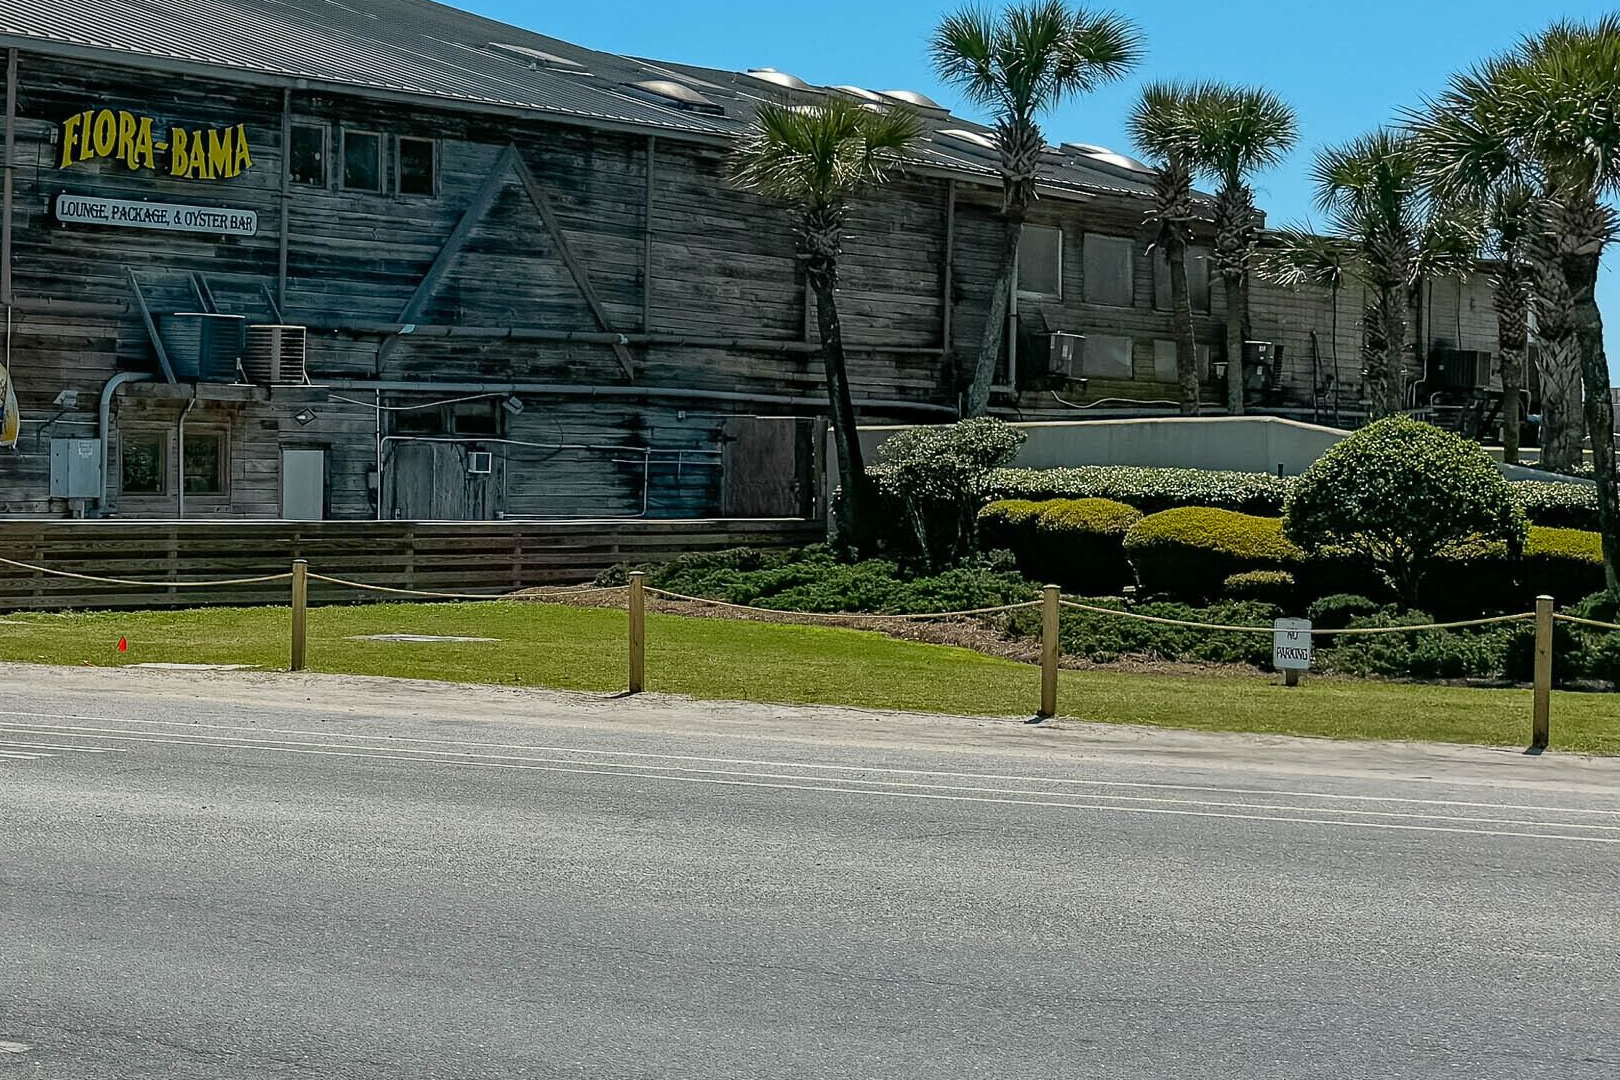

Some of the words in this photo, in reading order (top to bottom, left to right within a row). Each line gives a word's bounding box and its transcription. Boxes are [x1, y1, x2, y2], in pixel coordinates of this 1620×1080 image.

[60, 109, 252, 179] FLORA-BAMA
[61, 201, 109, 220] LOUNGE,
[112, 205, 169, 226] PACKAGE,
[174, 210, 183, 225] &
[185, 210, 228, 228] OYSTER
[230, 216, 253, 232] BAR
[1276, 647, 1308, 660] PARKING
